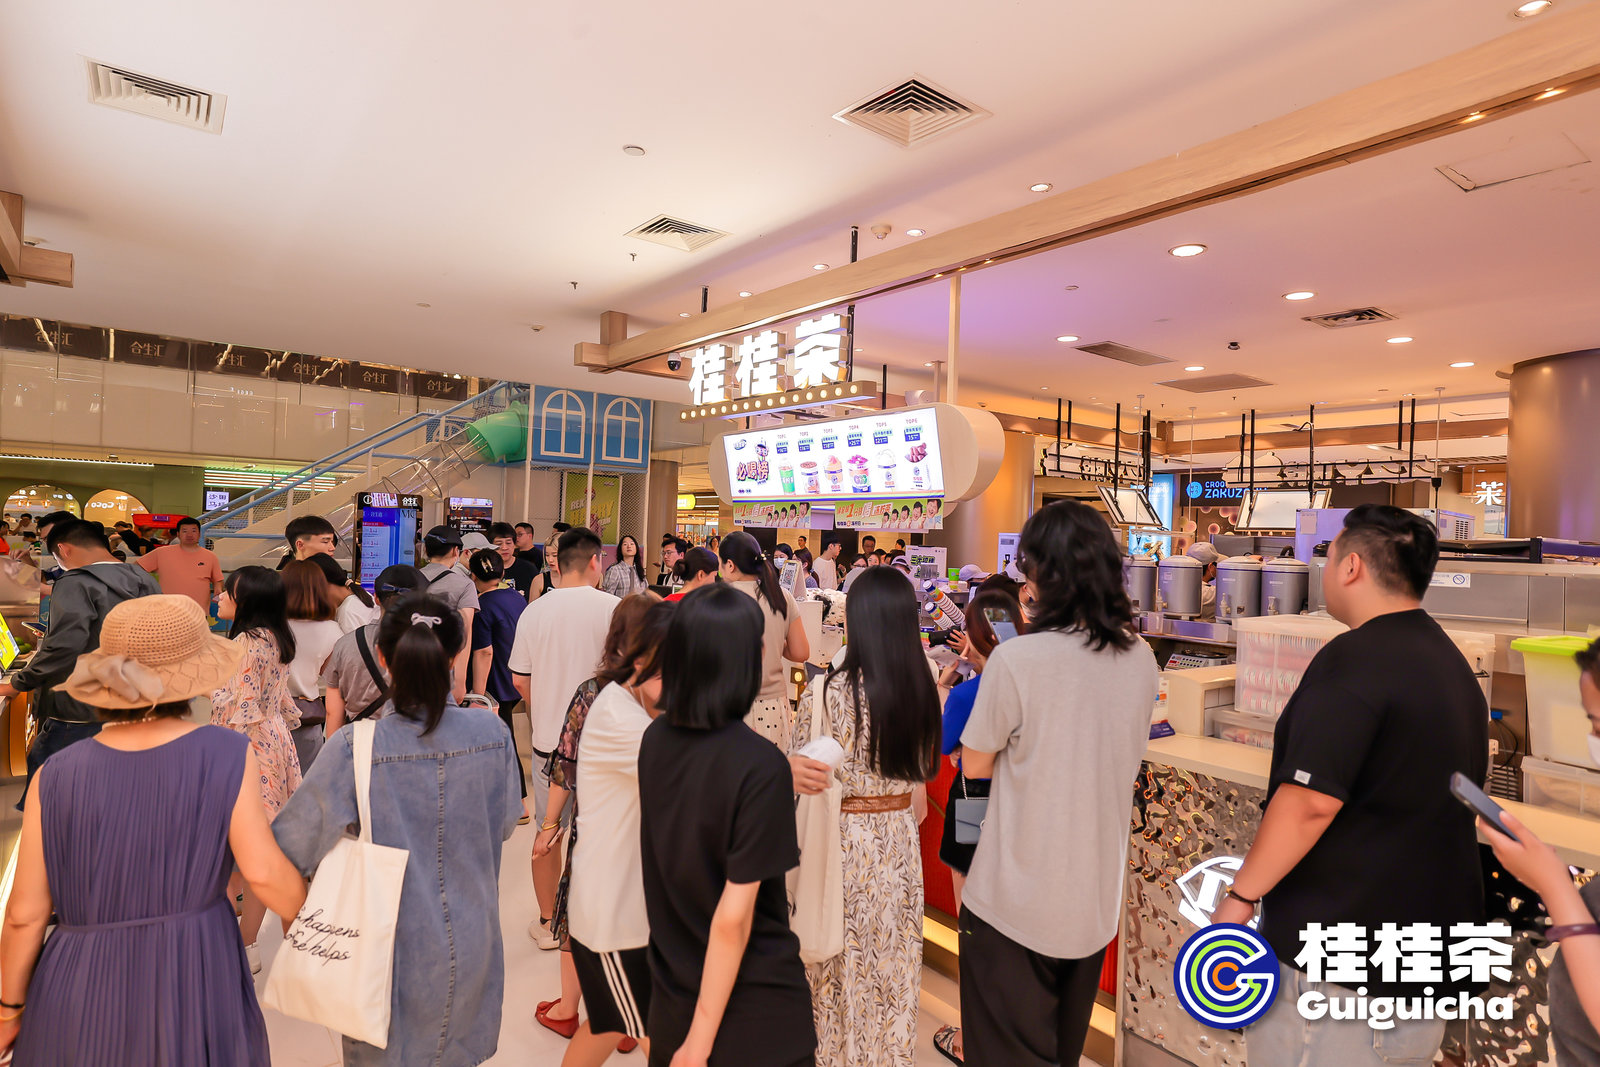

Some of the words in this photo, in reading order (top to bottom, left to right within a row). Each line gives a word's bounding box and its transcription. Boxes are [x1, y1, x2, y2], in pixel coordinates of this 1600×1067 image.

[129, 340, 165, 358] 合生汇
[689, 313, 847, 406] 桂桂茶
[362, 370, 389, 385] 合生汇
[451, 502, 463, 511] B2
[308, 941, 352, 967] helps
